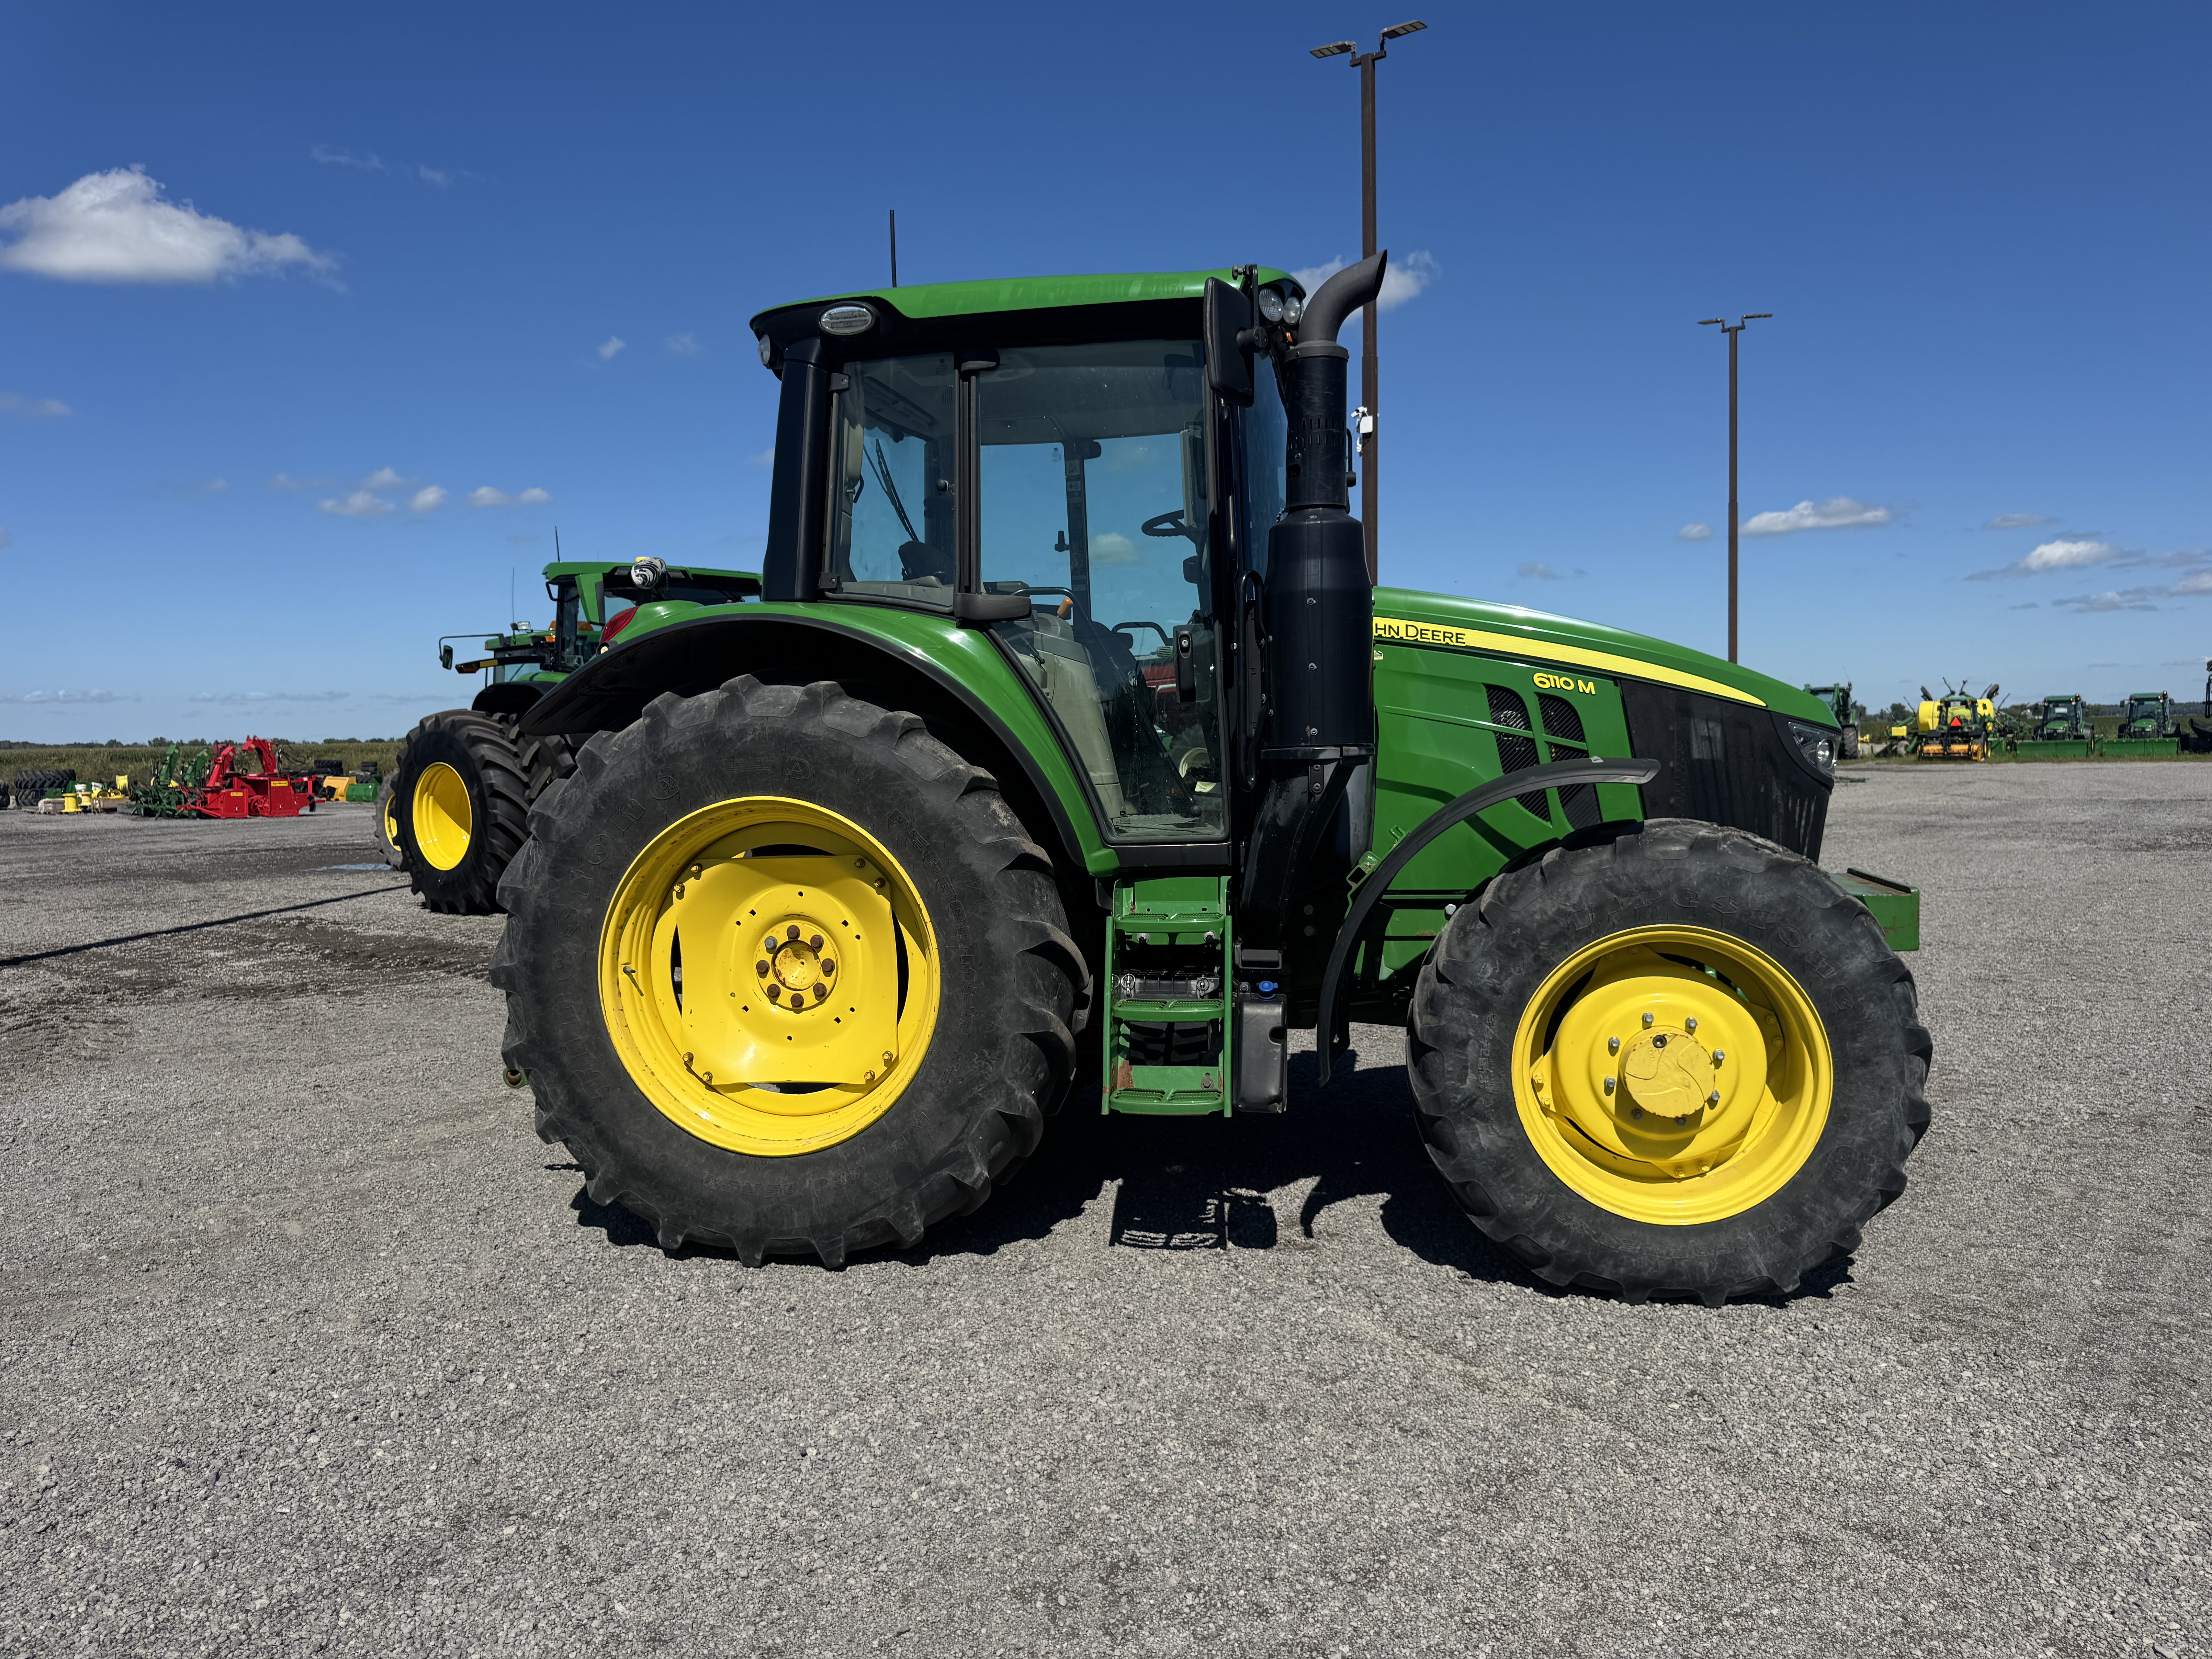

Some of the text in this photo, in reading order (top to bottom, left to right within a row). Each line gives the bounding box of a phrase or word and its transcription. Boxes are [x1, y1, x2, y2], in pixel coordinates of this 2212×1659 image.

[1375, 623, 1465, 644] HN DEERE
[1533, 673, 1595, 695] 6110 M
